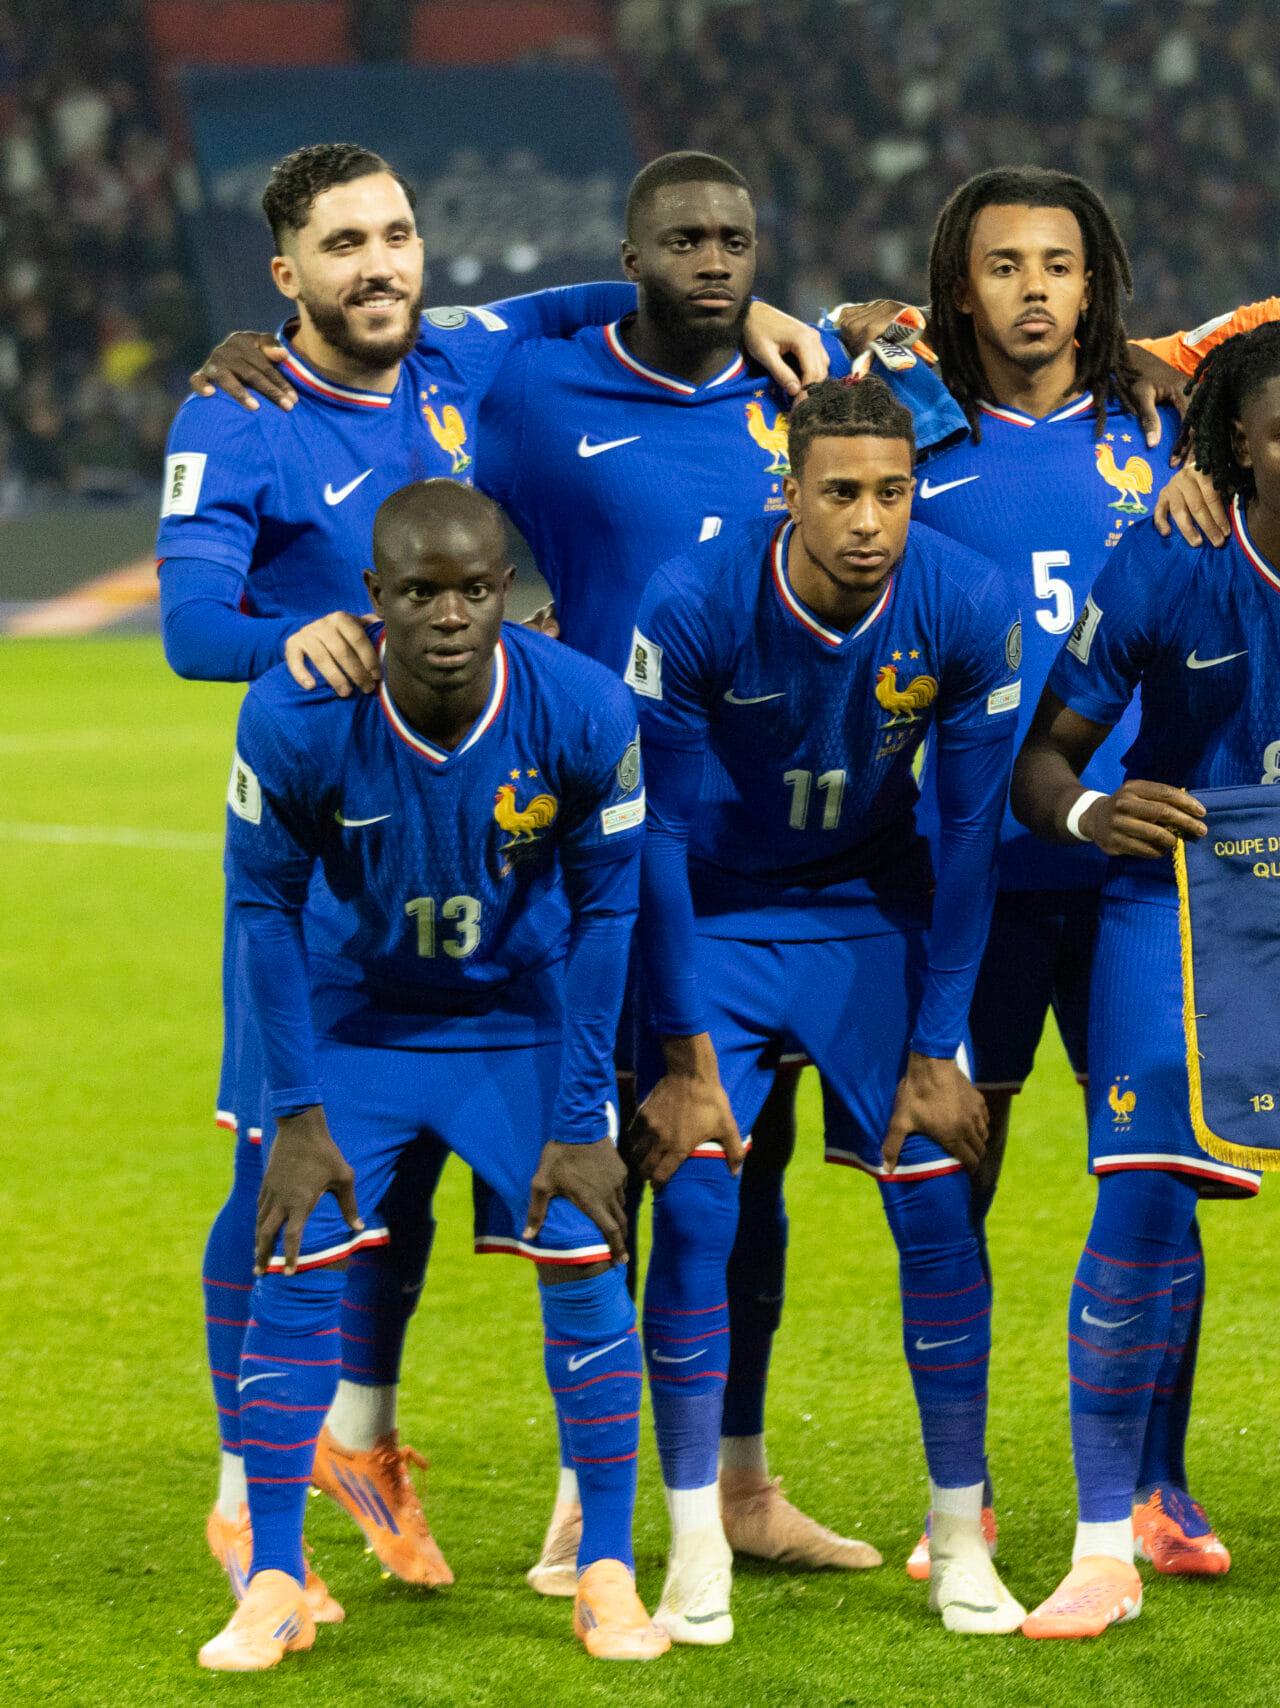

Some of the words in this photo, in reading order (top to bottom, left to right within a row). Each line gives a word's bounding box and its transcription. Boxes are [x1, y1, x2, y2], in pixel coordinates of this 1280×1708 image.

[1031, 550, 1075, 634] 5
[783, 768, 847, 830] 11
[1214, 837, 1265, 856] COUPE
[404, 895, 482, 959] 13
[1249, 1093, 1274, 1113] 13
